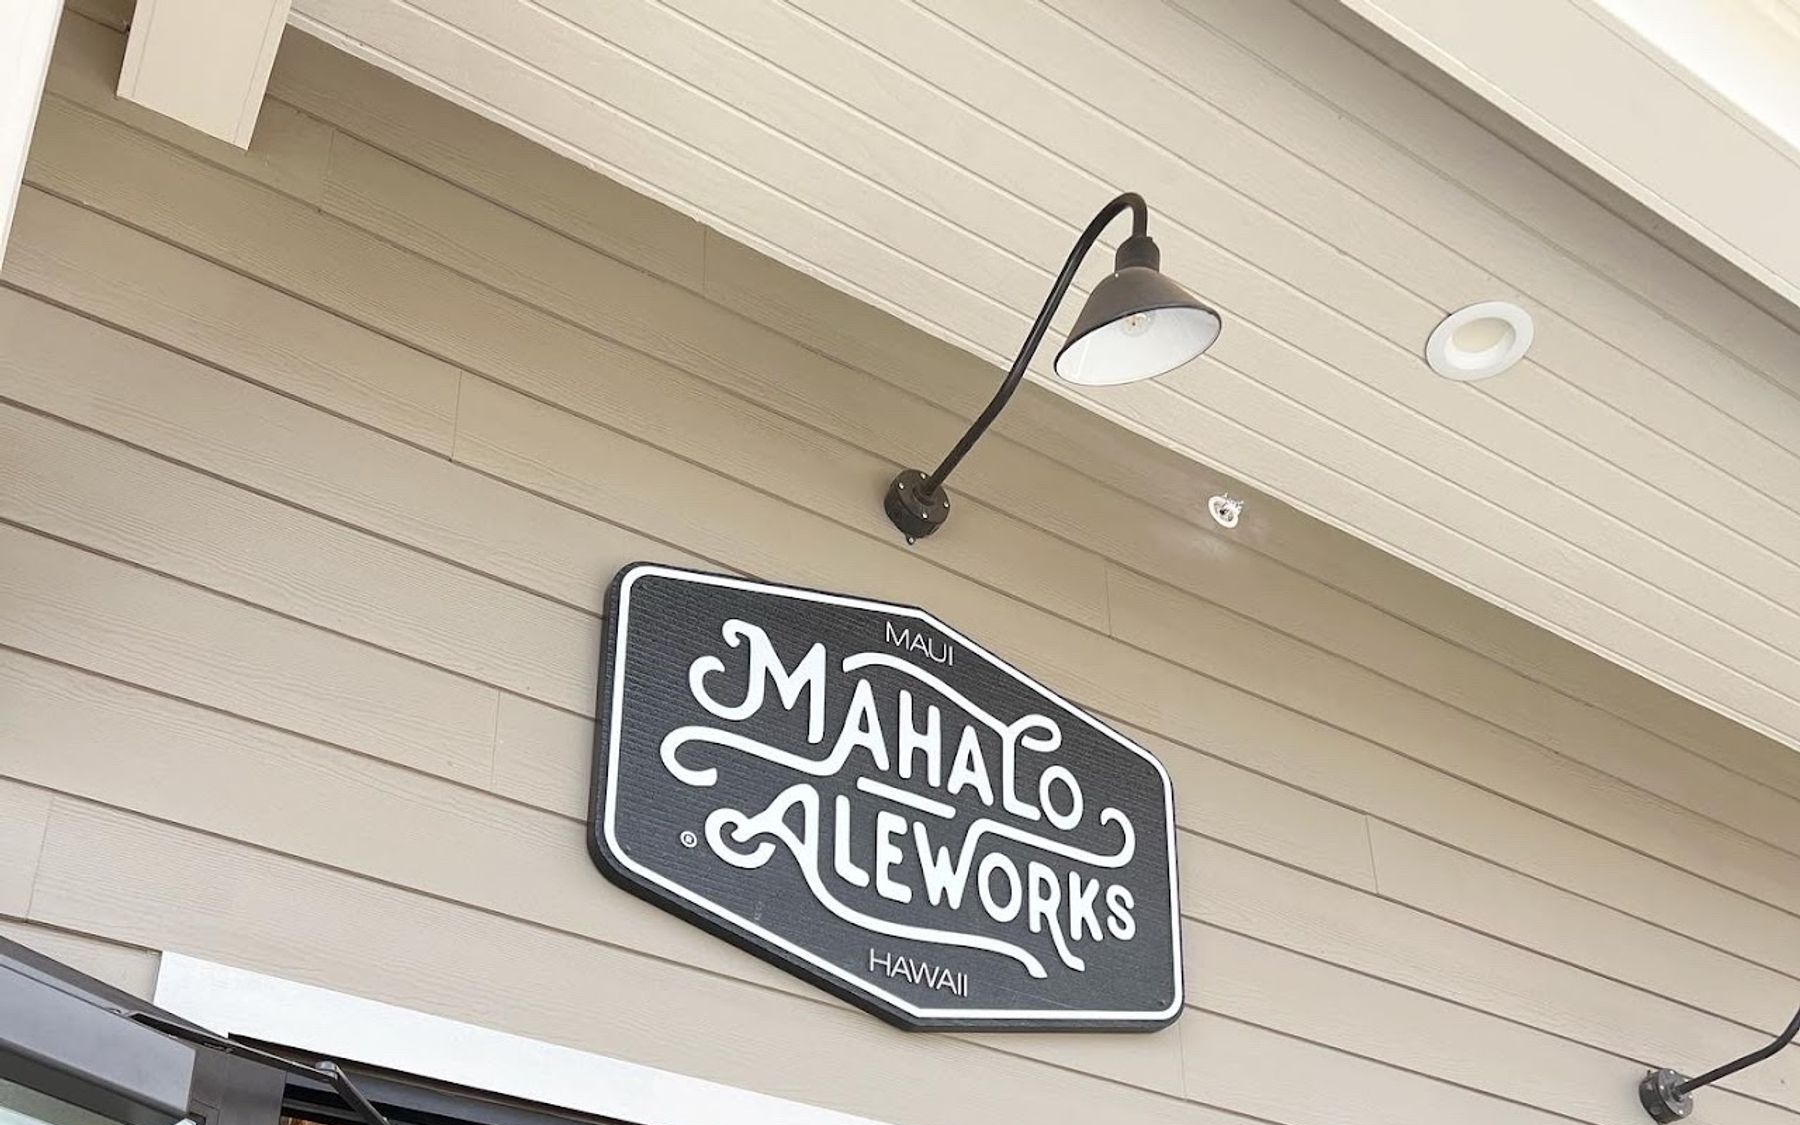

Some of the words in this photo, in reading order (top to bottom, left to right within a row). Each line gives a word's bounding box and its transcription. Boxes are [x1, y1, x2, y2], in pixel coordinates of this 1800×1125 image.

[885, 621, 954, 666] MAUI
[660, 617, 1084, 830] MAHALO
[704, 783, 1137, 978] ALEWORKS
[868, 947, 969, 998] HAWAII
